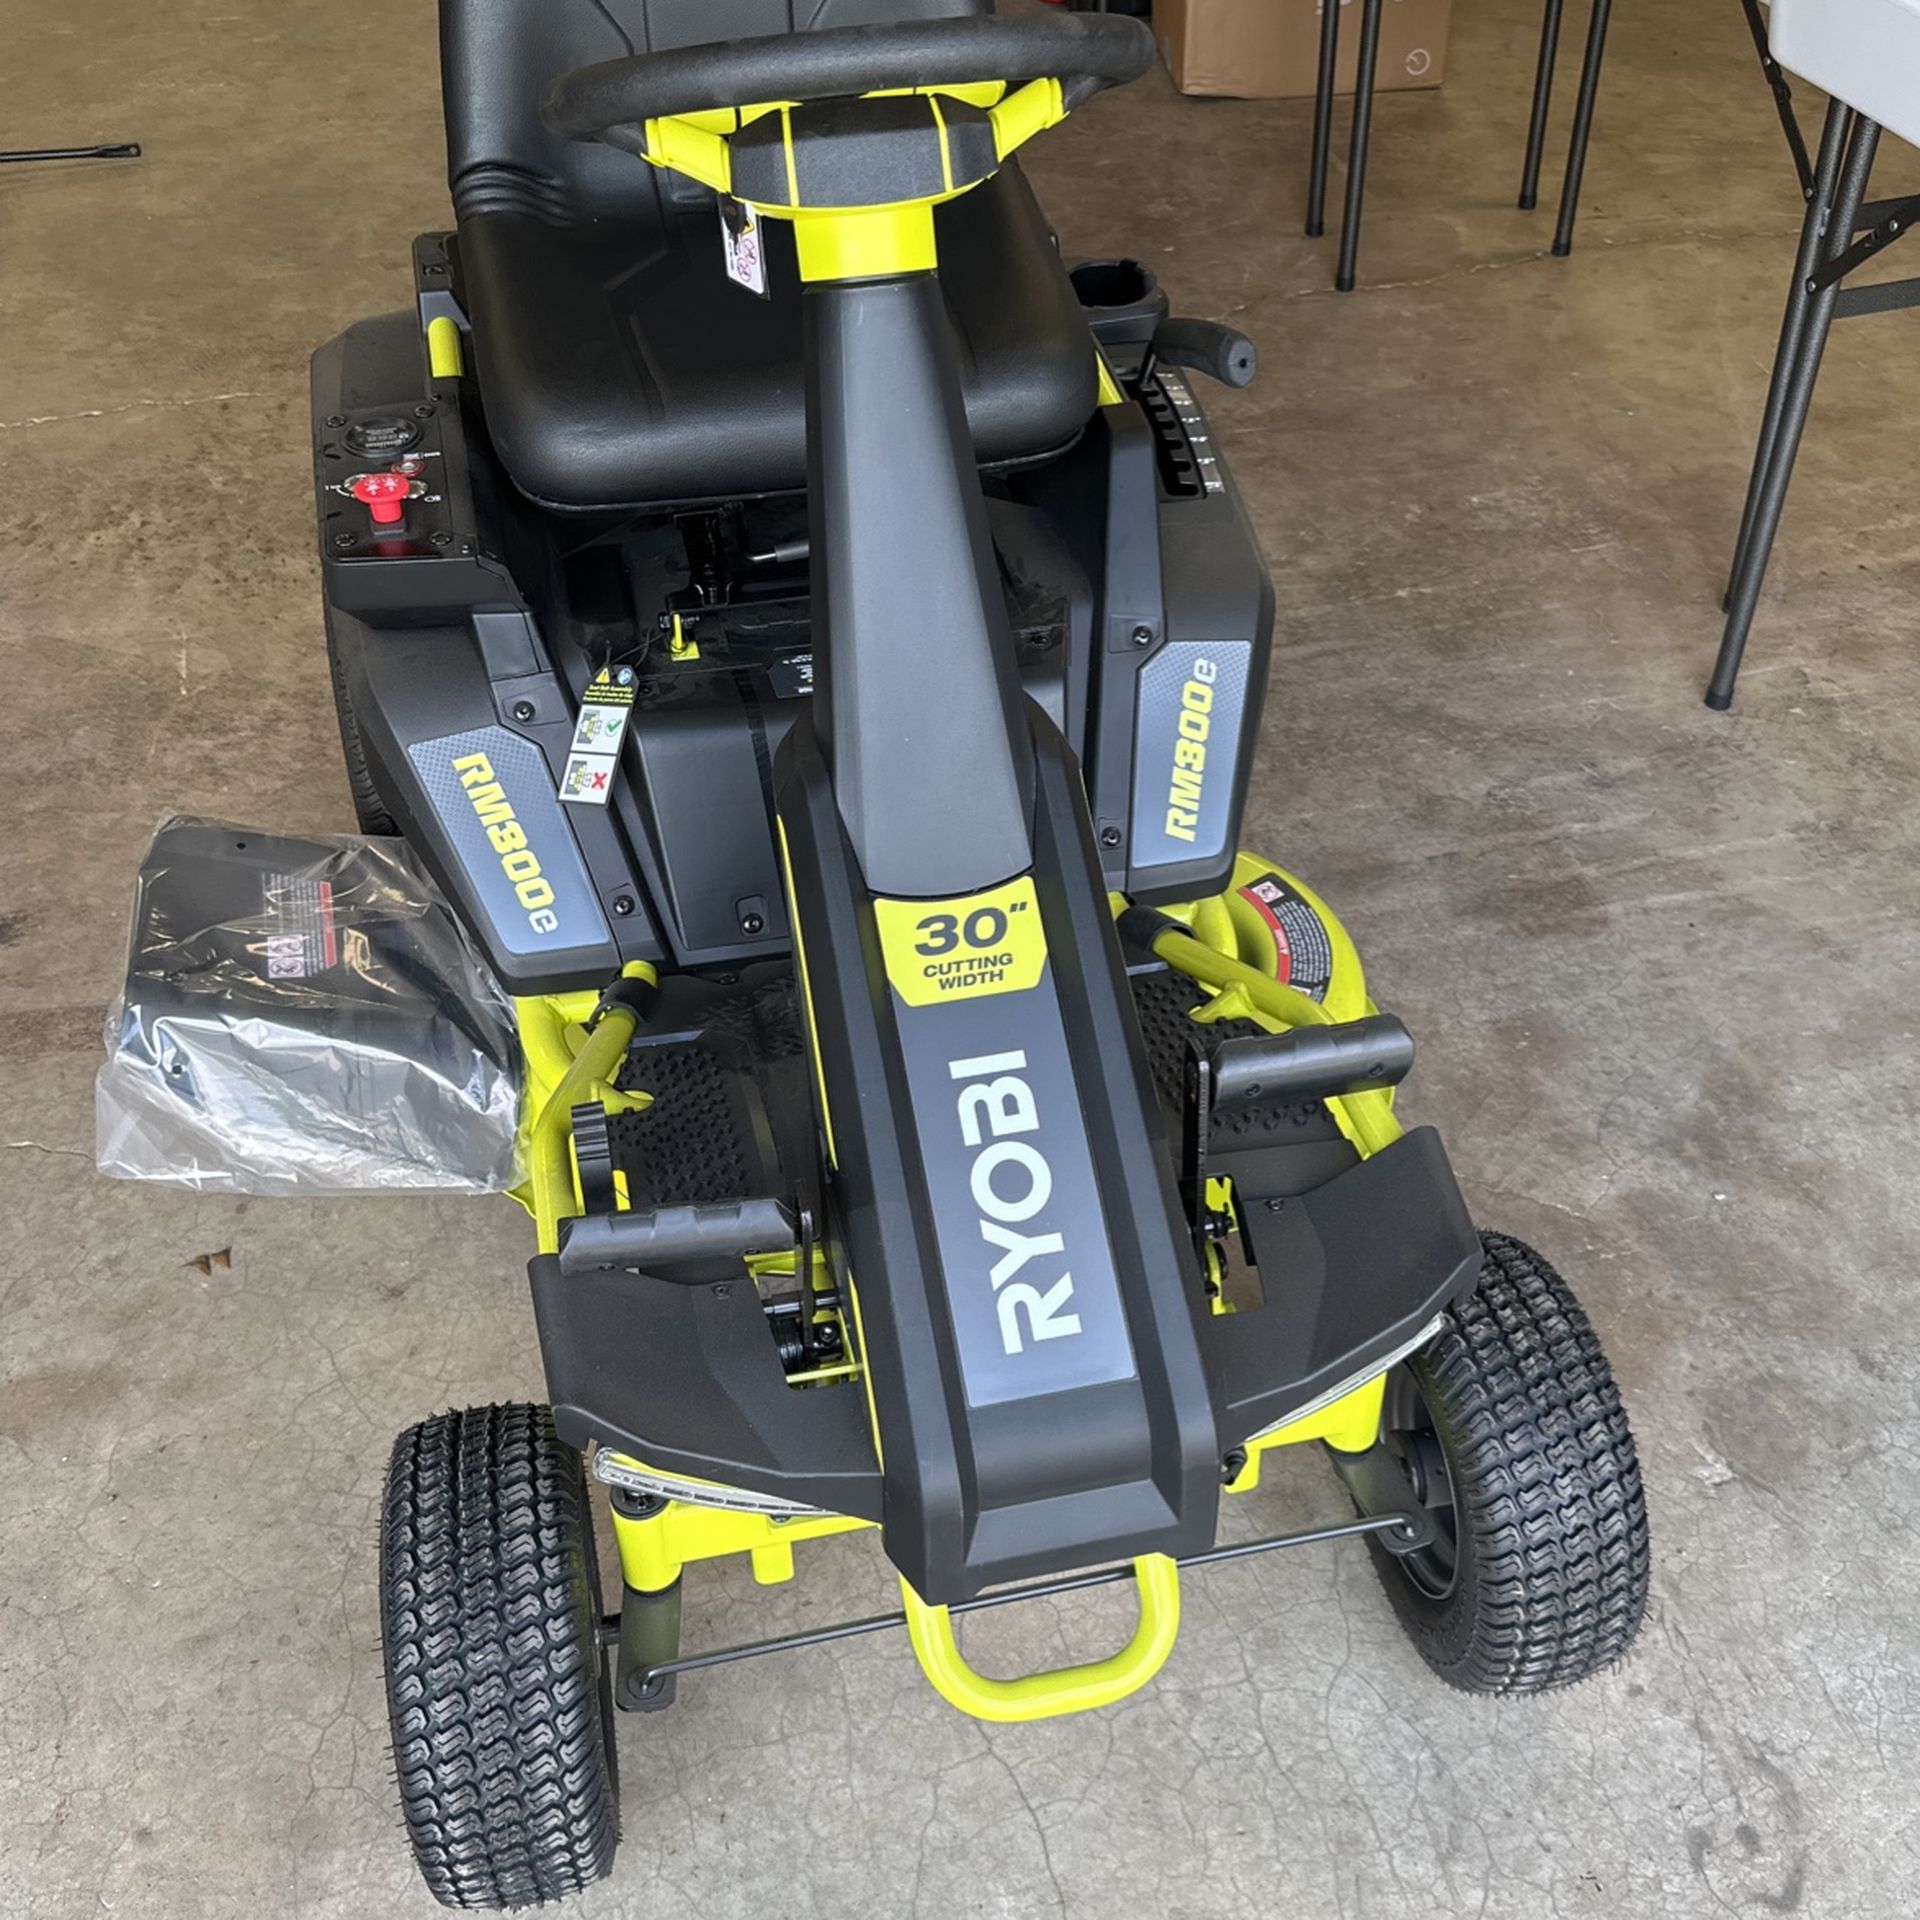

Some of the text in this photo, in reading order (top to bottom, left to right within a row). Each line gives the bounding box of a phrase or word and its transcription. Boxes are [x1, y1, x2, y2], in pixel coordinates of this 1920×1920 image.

[1165, 658, 1217, 843] RM300e
[452, 752, 558, 934] RM300e
[914, 901, 1028, 956] 30"
[923, 953, 1013, 978] CUTTING
[938, 969, 1004, 991] WIDTH
[948, 1049, 1082, 1355] RYOBI
